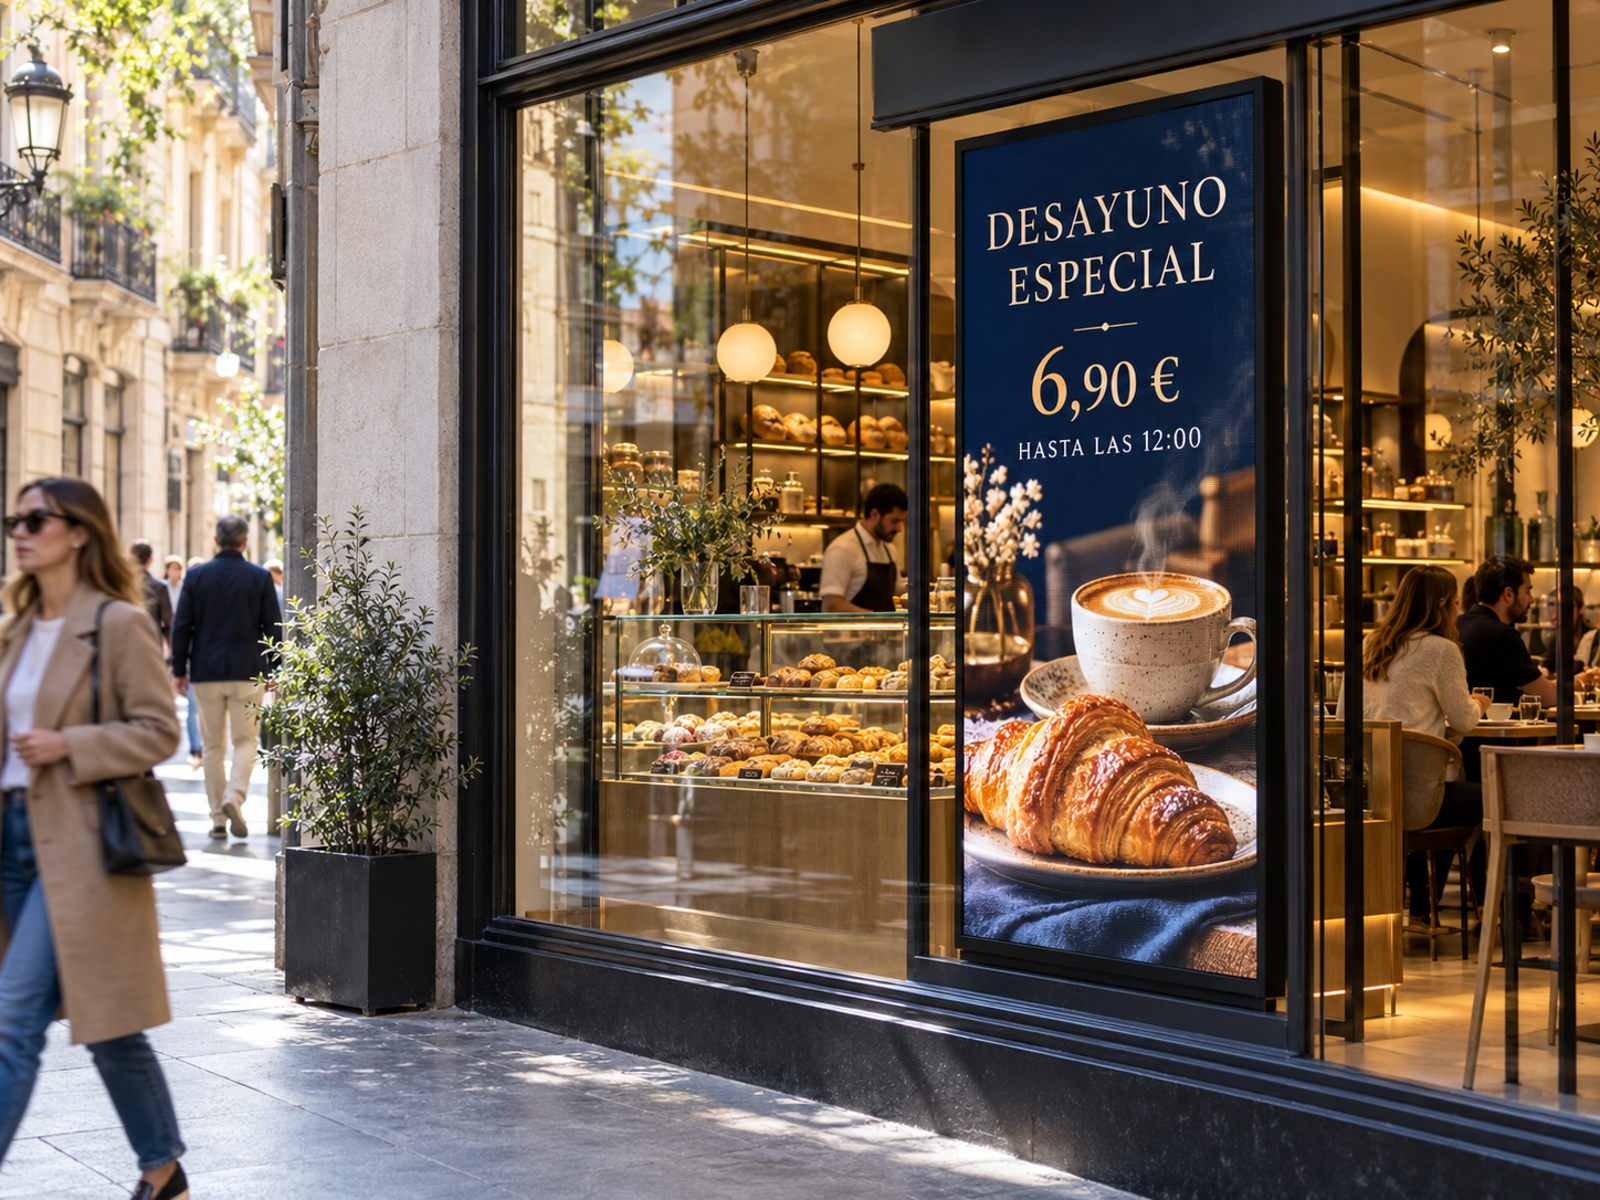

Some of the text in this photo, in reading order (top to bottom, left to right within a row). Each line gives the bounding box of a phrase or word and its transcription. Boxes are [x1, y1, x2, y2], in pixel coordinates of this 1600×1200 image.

[987, 175, 1227, 251] DESAYUNO
[1008, 241, 1215, 306] ESPECIAL
[1031, 345, 1180, 422] 6,90 €
[1018, 426, 1201, 461] HASTA LAS 12:00
